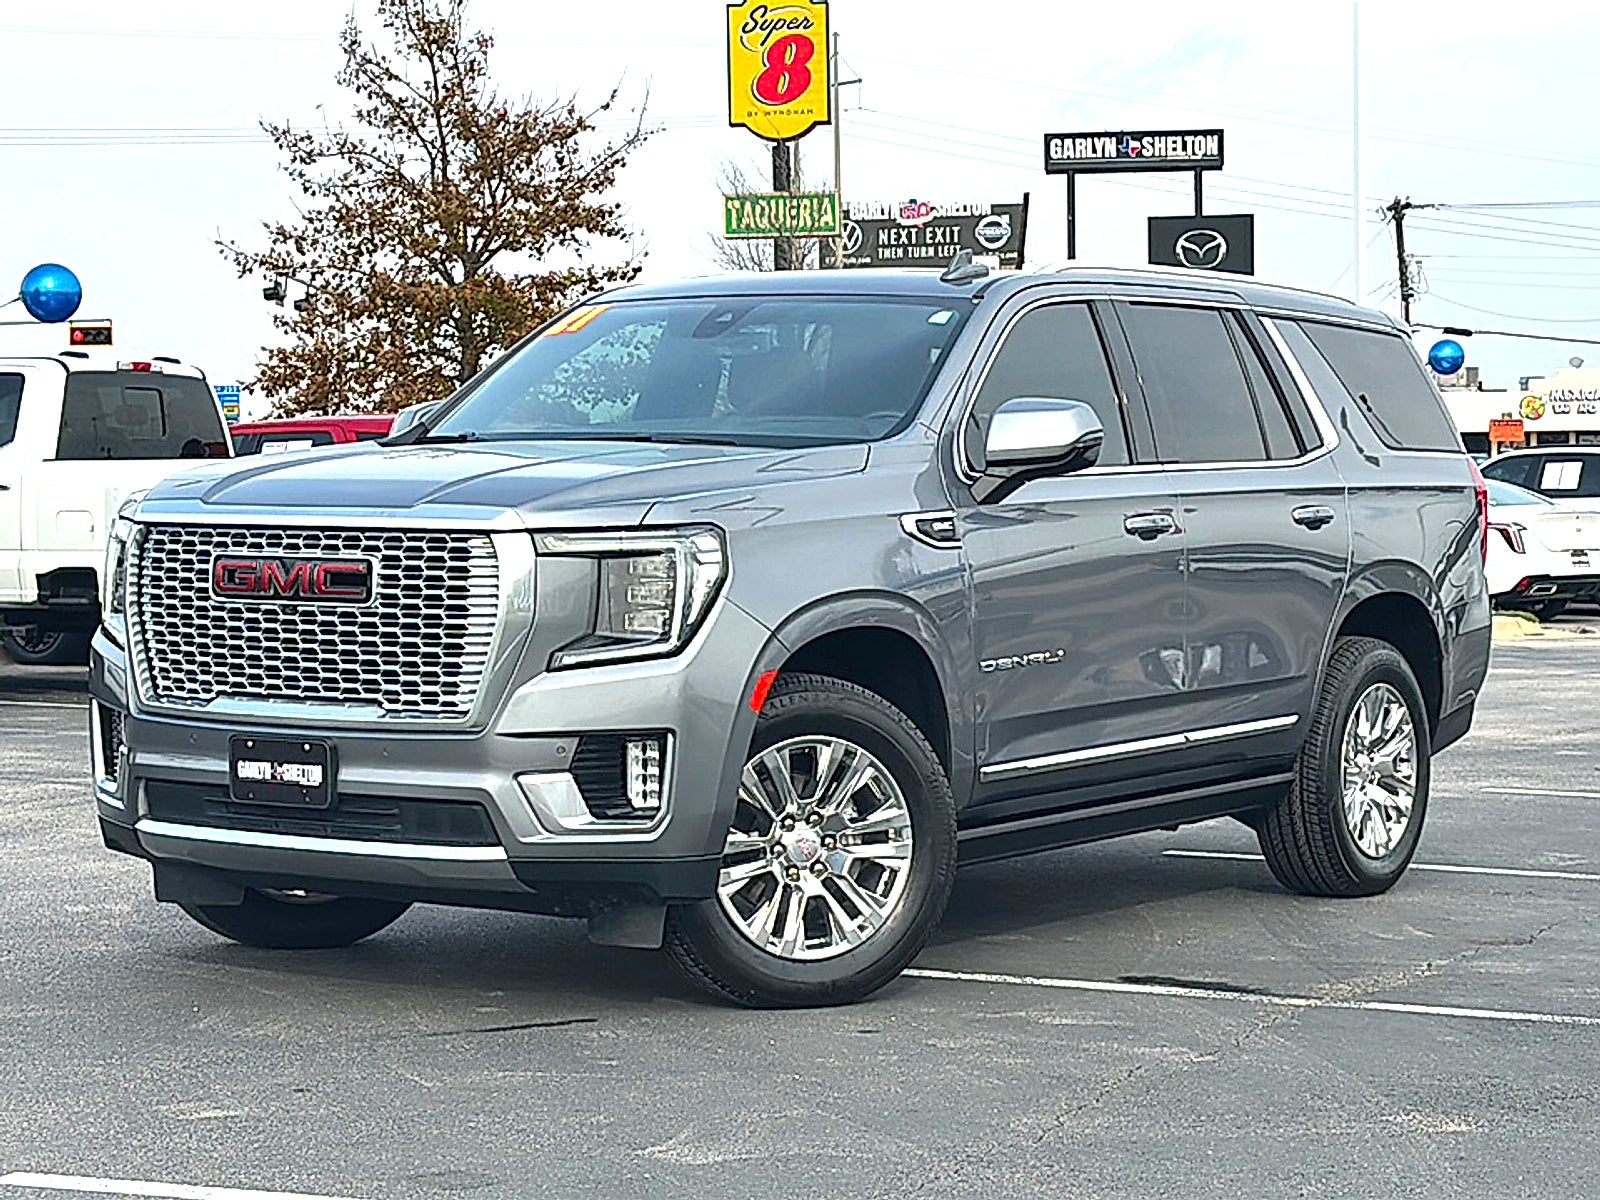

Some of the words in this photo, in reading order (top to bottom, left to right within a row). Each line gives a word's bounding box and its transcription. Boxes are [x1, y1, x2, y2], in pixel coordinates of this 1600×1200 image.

[741, 4, 815, 47] Super
[751, 33, 815, 106] 8
[764, 108, 814, 116] WYNDHAM
[1049, 136, 1118, 160] GARLYN
[1141, 134, 1219, 158] SHELTON
[727, 197, 835, 230] TAQUERIA
[878, 226, 919, 246] NEXT
[925, 225, 962, 244] EXIT
[877, 246, 904, 260] THEN
[907, 245, 934, 259] TURN
[938, 244, 962, 257] LEFT
[214, 559, 368, 599] GMC
[979, 649, 1066, 673] DENALI
[237, 760, 272, 780] GARLYN
[281, 763, 322, 783] SHELTON
